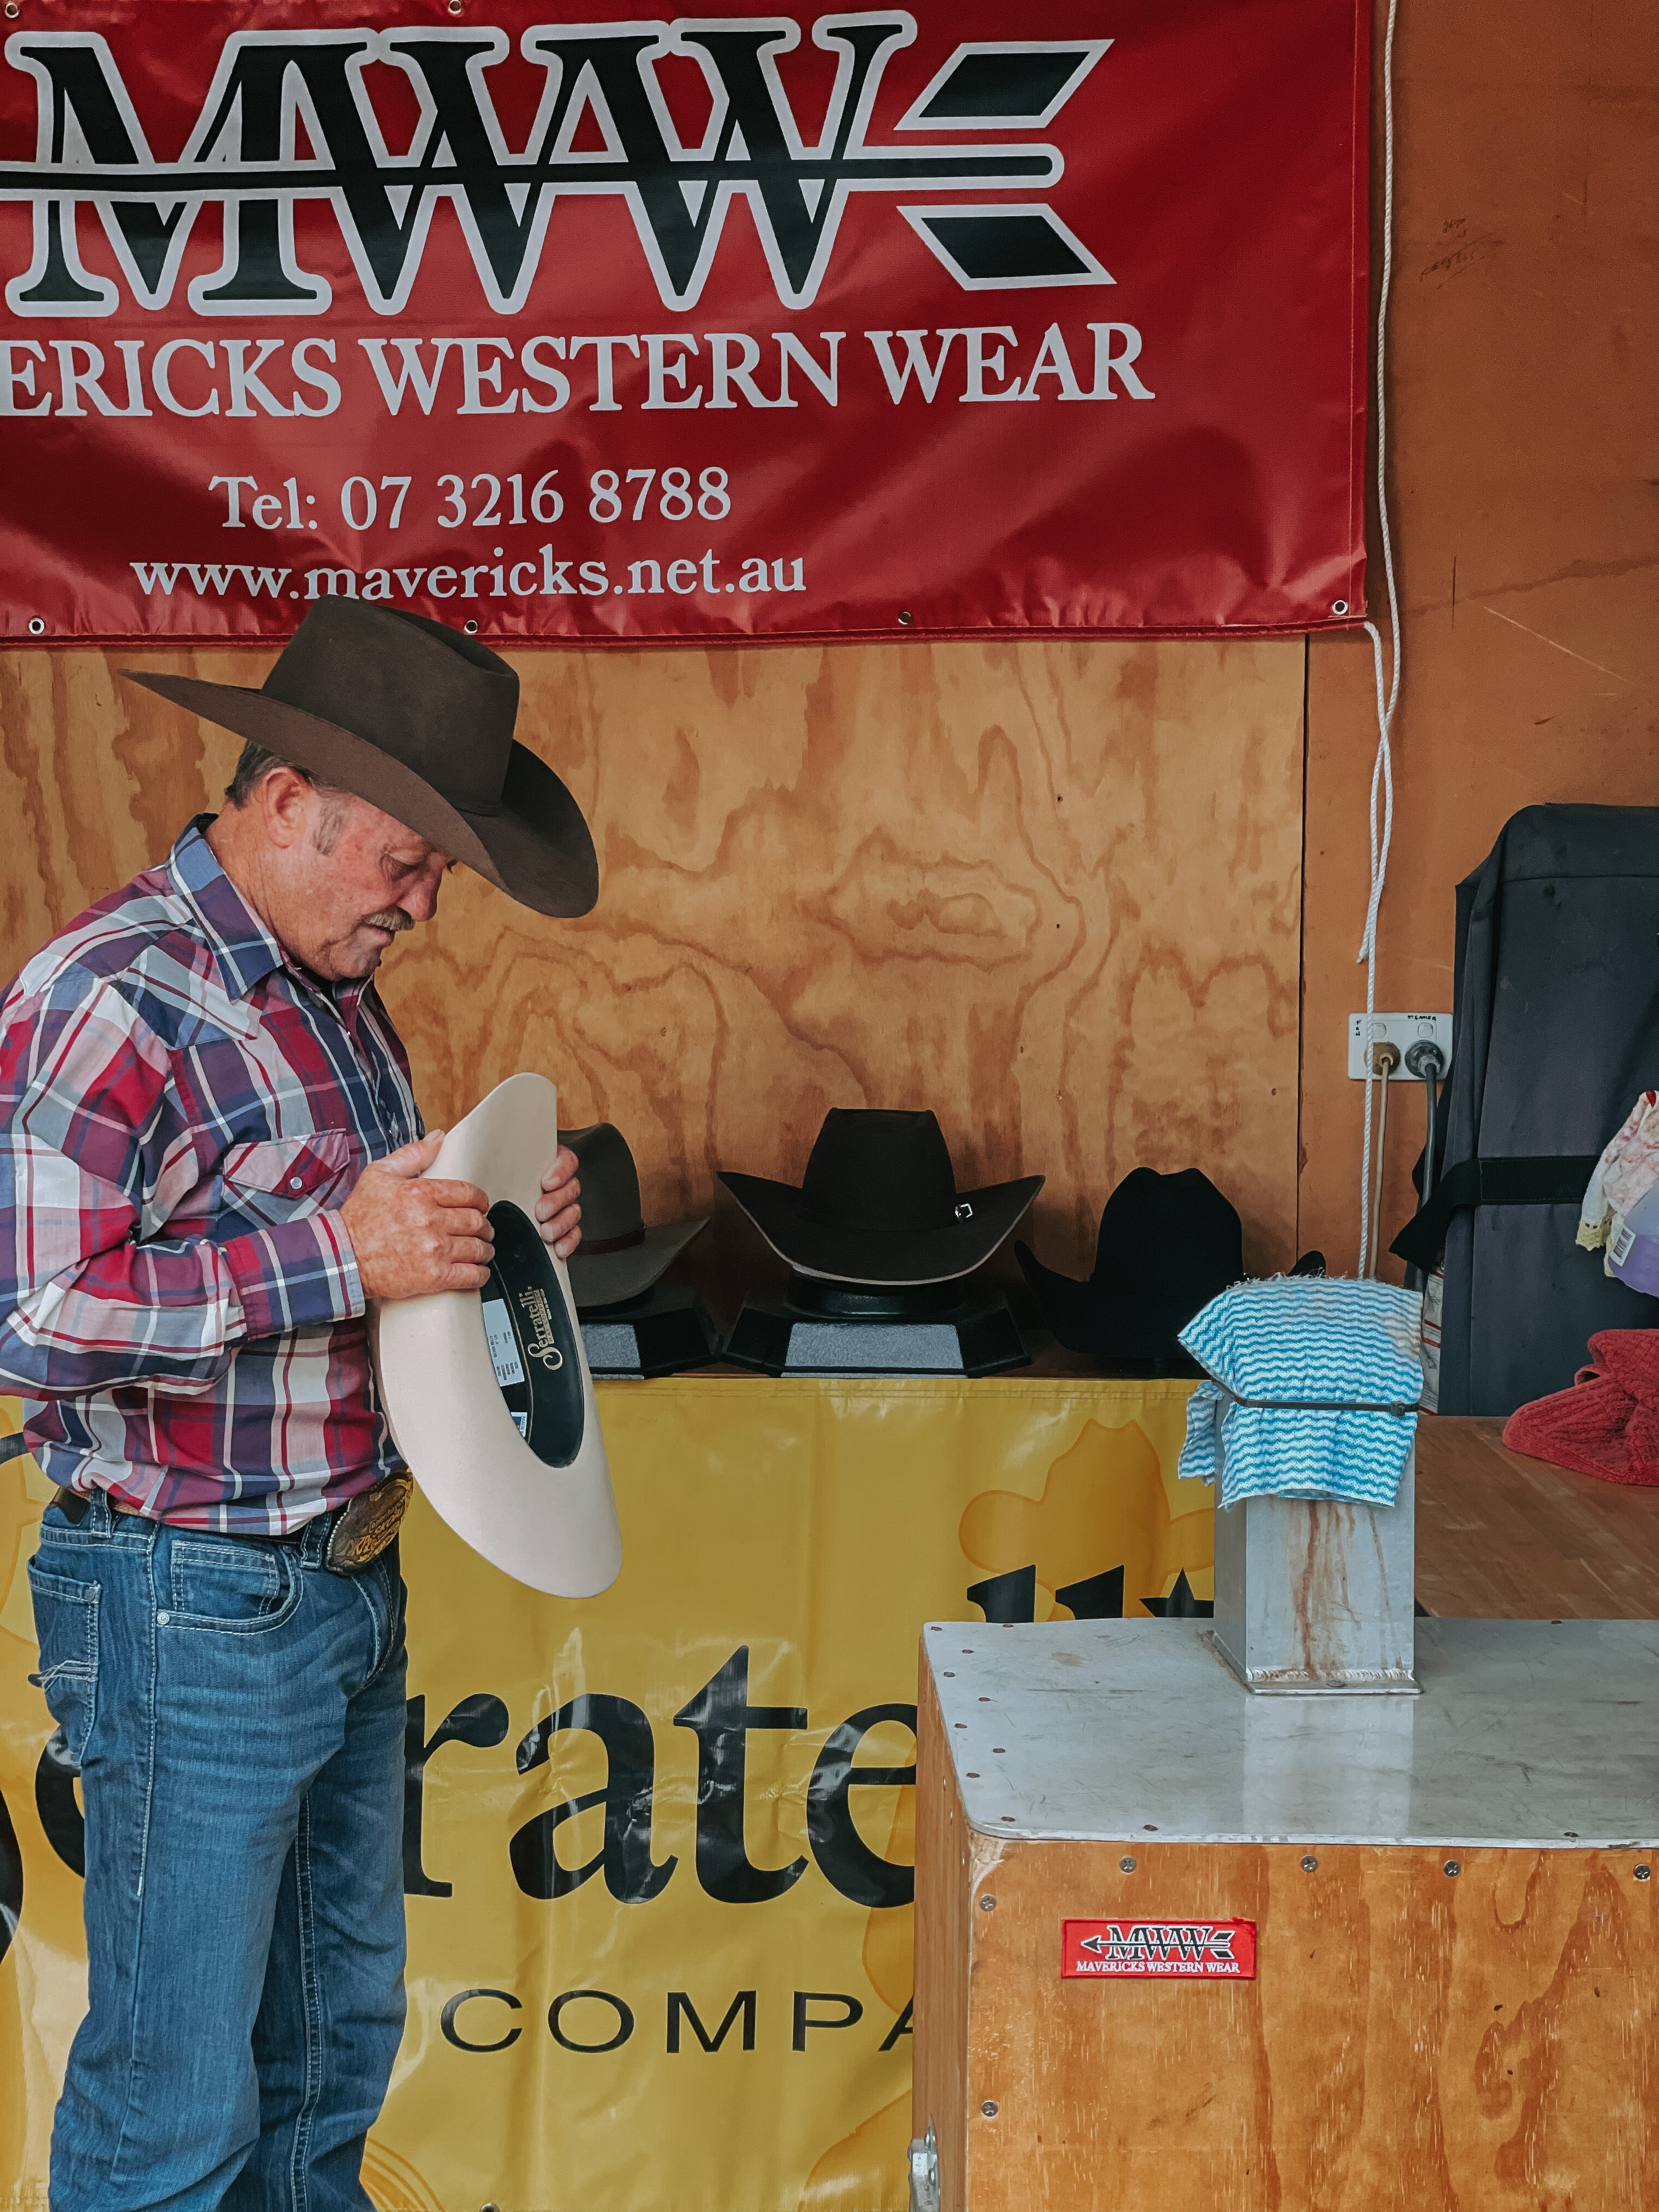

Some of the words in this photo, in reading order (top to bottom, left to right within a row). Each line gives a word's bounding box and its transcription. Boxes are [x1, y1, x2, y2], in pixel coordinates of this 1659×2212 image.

[0, 338, 342, 417] ERICKS
[358, 331, 847, 416] WESTERN
[864, 322, 1155, 405] WEAR
[208, 475, 317, 531] Tel:
[340, 475, 413, 531] 07
[437, 470, 564, 529] 3216
[589, 466, 732, 523] 8788
[129, 543, 806, 601] www.mavericks.net.au
[518, 1290, 563, 1370] Serratelli
[1075, 1960, 1146, 1973] MAVERICKS
[1147, 1961, 1204, 1974] WESTERN
[1206, 1961, 1241, 1974] WEAR
